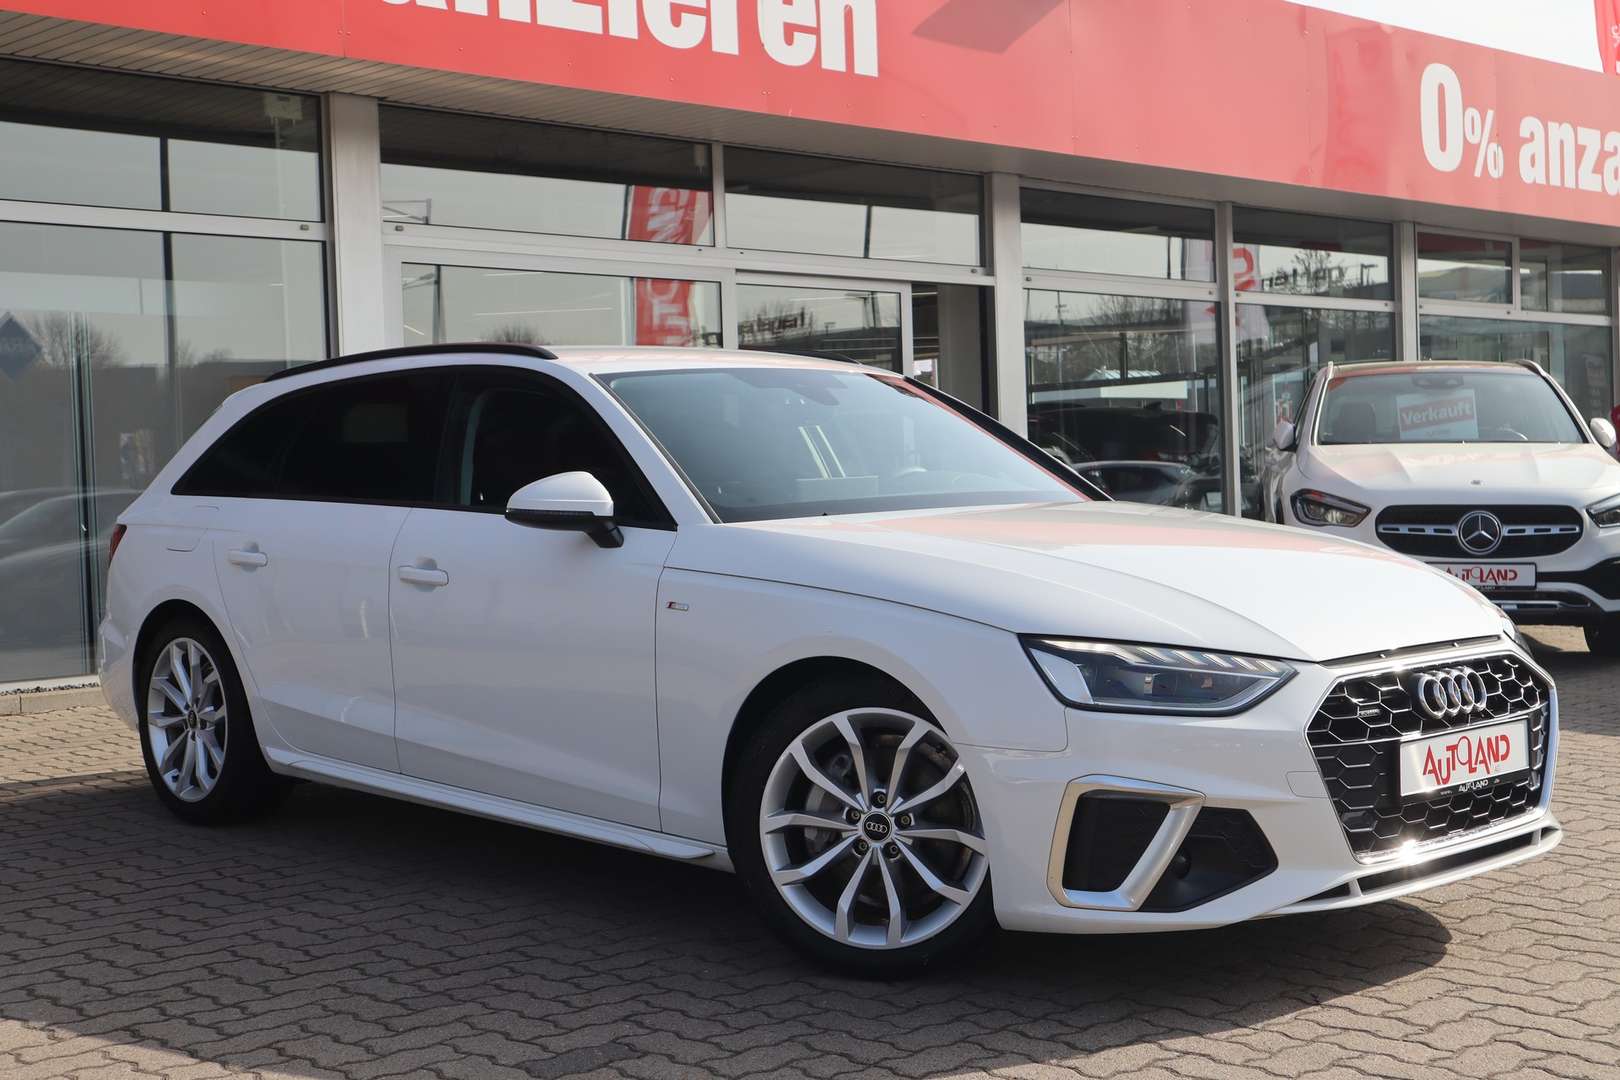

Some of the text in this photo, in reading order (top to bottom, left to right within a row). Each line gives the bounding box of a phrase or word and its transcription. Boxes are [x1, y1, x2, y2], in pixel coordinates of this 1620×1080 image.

[1420, 62, 1504, 179] 0%
[1401, 402, 1473, 425] Verkauft
[1423, 734, 1511, 786] AUTOLAND
